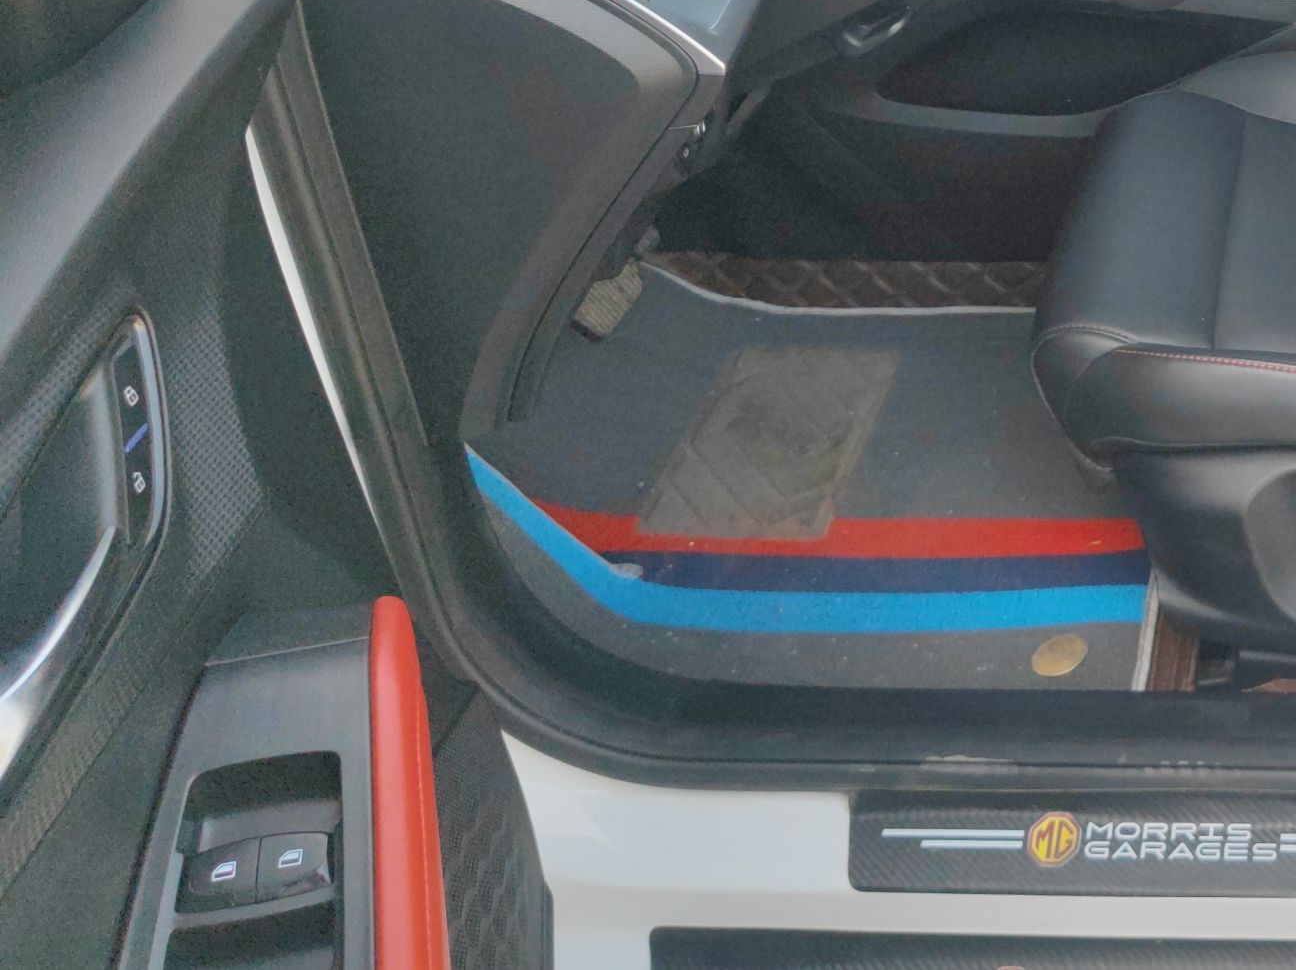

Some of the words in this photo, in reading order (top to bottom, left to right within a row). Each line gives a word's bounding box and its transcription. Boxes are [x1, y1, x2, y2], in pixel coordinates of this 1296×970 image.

[1033, 816, 1077, 865] MG
[1085, 821, 1252, 842] MORRIS
[1083, 840, 1278, 862] GARAGES
